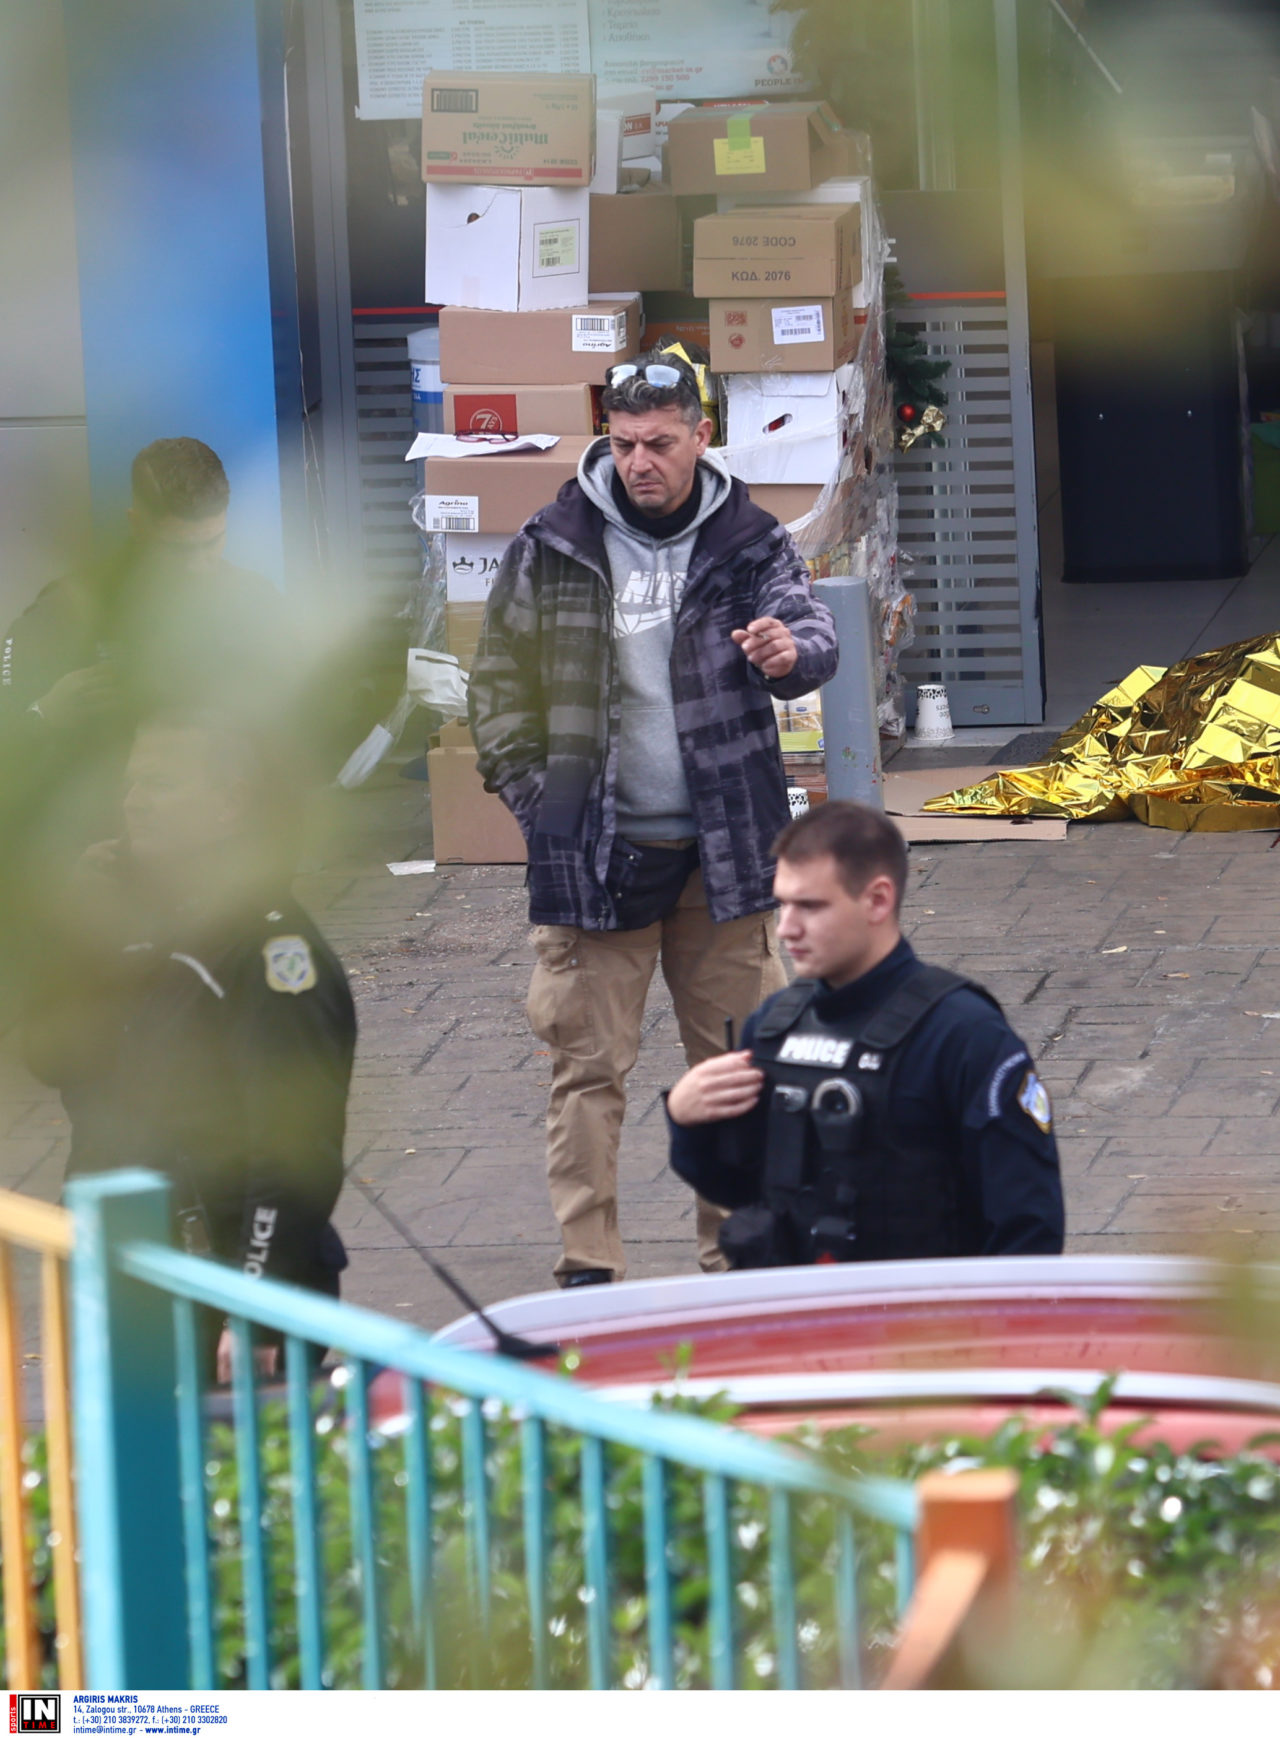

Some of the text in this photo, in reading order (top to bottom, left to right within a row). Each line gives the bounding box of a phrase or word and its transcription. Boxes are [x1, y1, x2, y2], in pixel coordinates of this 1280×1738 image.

[732, 236, 796, 247] CODE 2076
[731, 271, 791, 282] ΚΩΔ. 2076
[2, 637, 14, 686] POLICE
[780, 1036, 851, 1064] POLICE
[243, 1205, 279, 1280] OLICE
